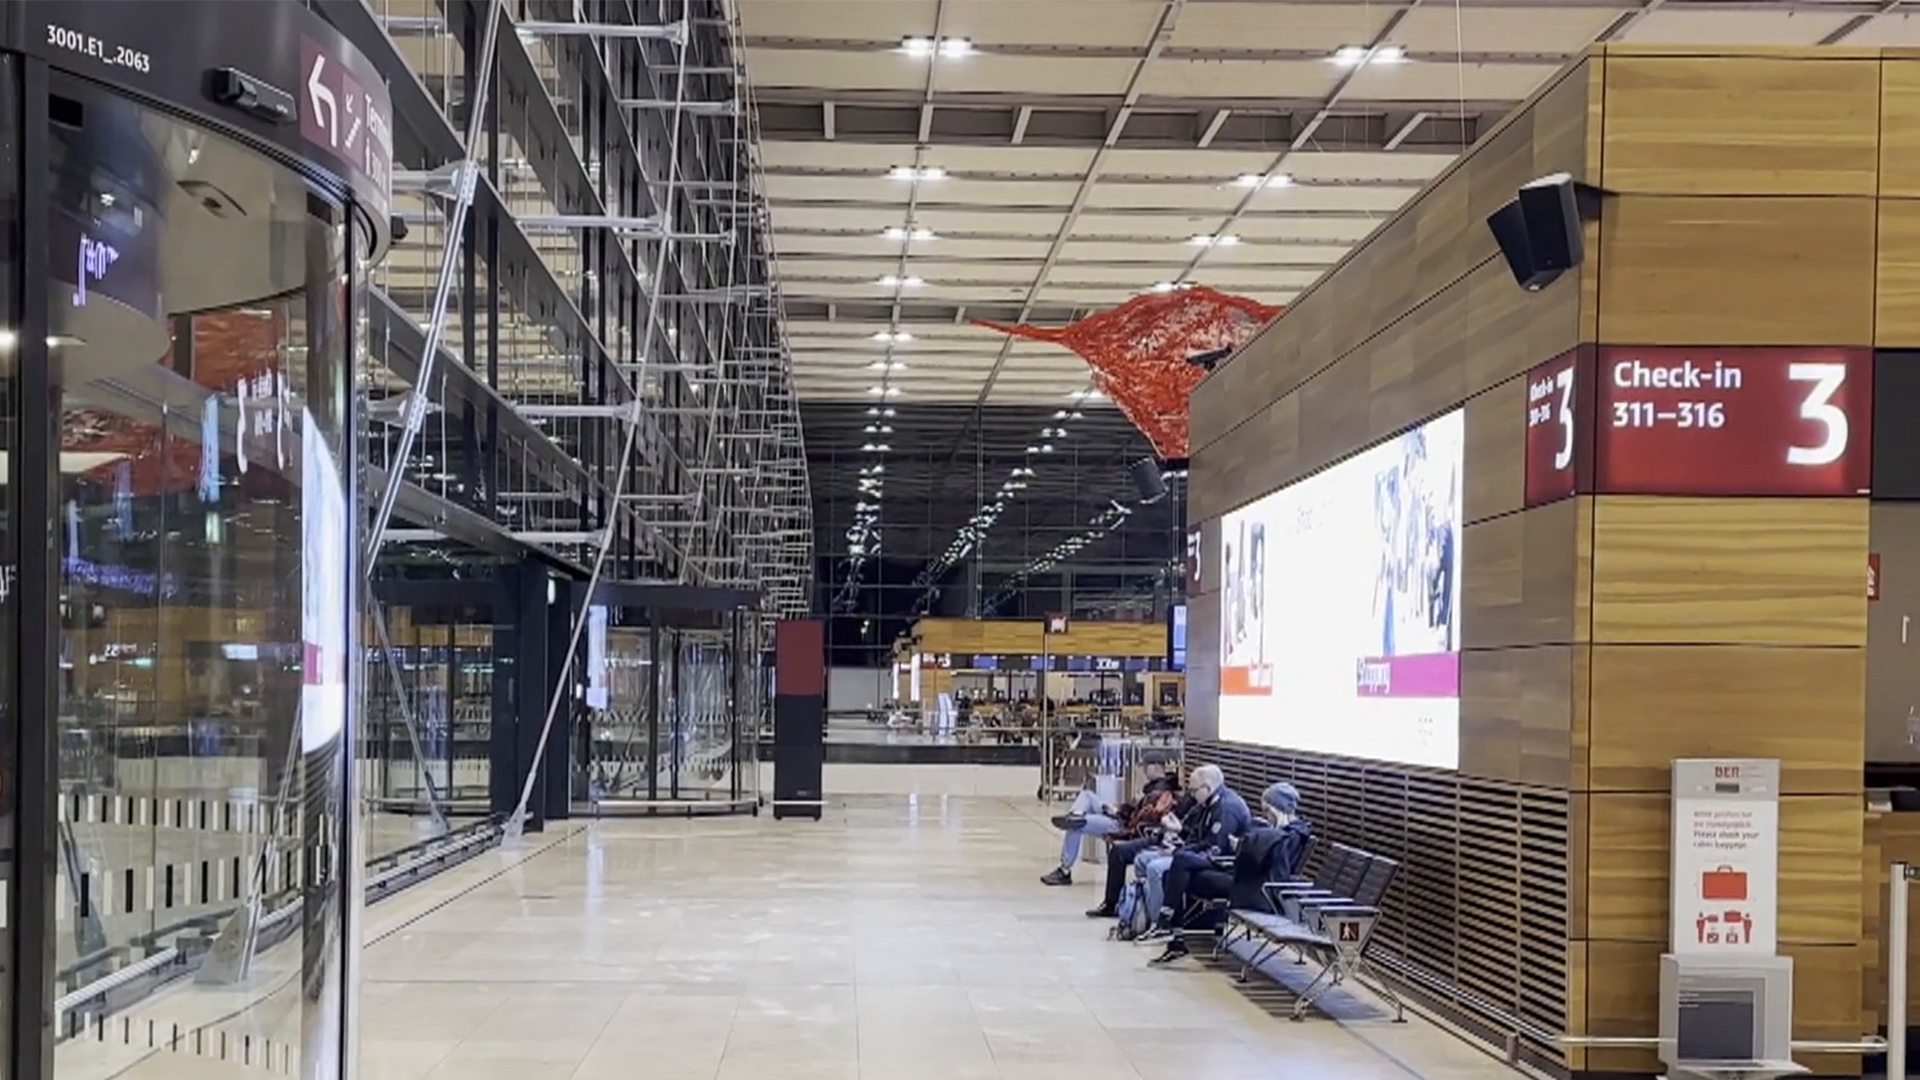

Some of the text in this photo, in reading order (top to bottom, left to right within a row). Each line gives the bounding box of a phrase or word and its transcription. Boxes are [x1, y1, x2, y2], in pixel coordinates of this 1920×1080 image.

[47, 25, 150, 73] 3001.E1_.2063
[1555, 366, 1574, 470] 3
[1614, 361, 1849, 466] Check-in 3
[1715, 766, 1740, 778] BER
